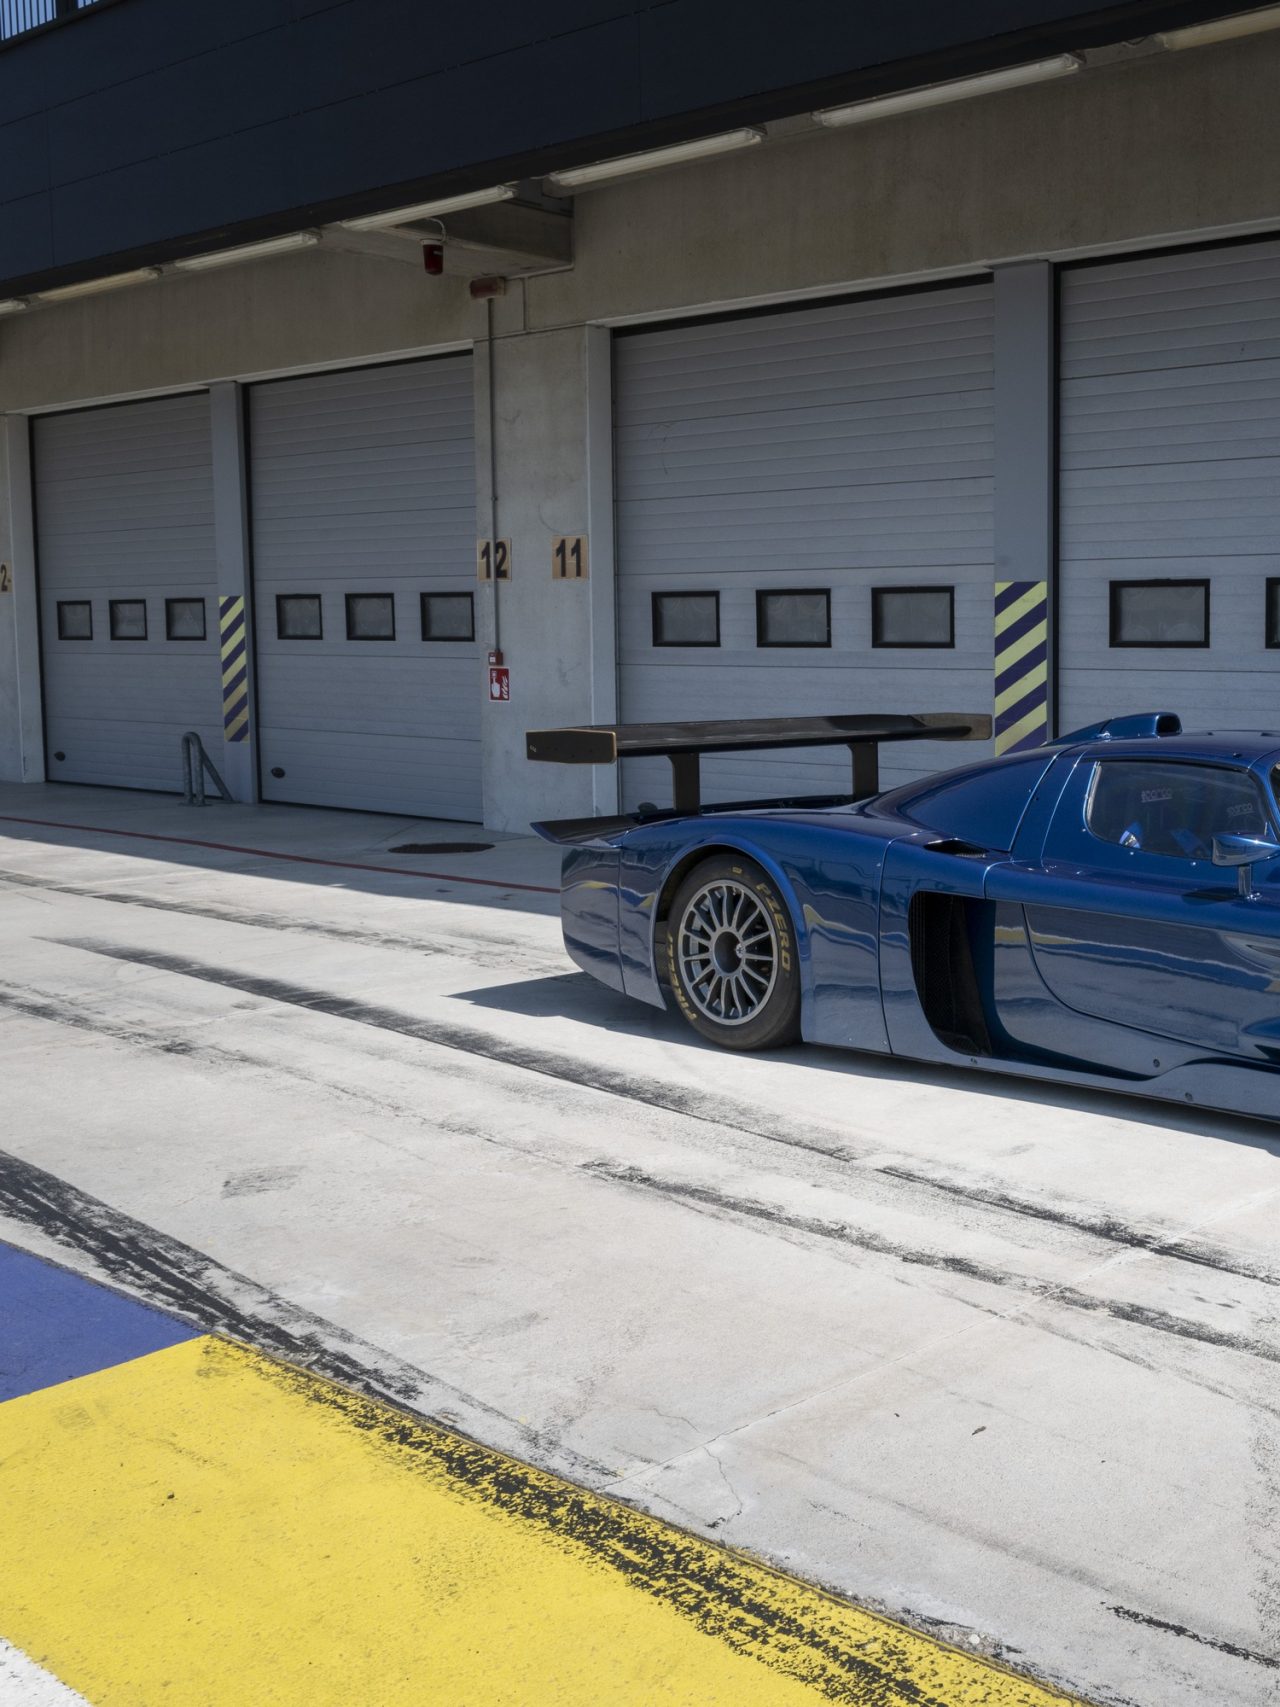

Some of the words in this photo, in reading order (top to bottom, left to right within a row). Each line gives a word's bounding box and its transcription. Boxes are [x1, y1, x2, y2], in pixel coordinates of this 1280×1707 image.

[481, 541, 508, 579] 12
[555, 538, 582, 578] 11
[765, 897, 791, 972] ZERO
